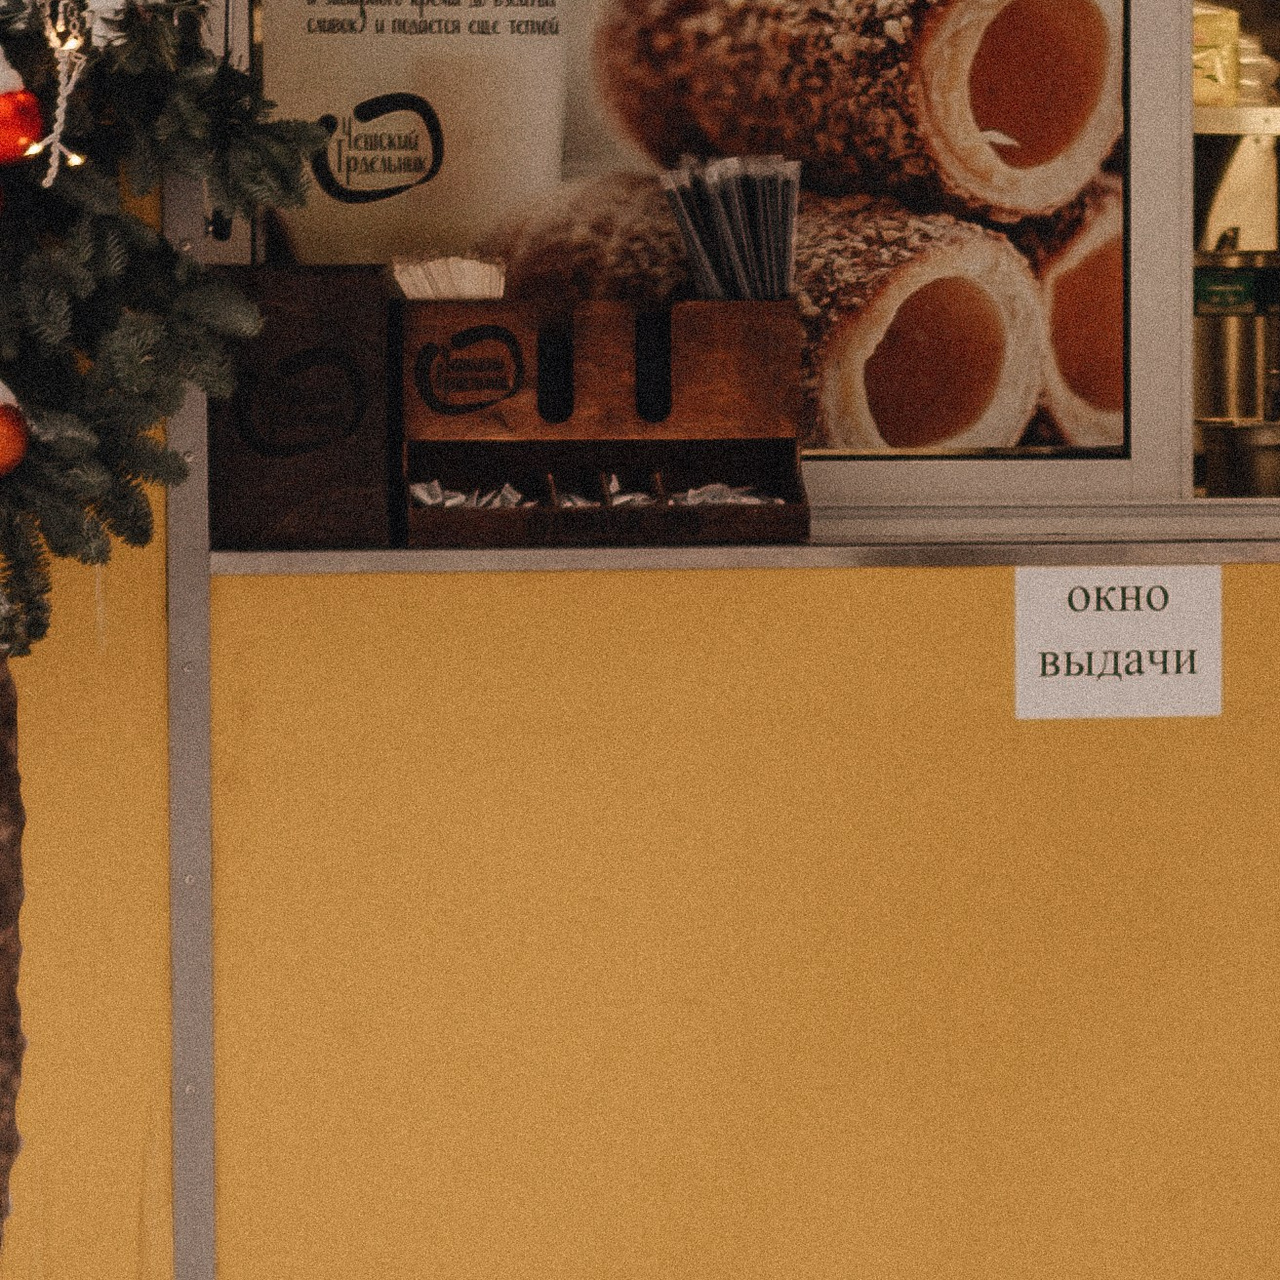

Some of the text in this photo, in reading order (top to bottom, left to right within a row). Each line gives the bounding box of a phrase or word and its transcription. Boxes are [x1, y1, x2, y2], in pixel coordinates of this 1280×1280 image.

[342, 115, 420, 151] Чешский
[1067, 584, 1170, 613] окно
[1038, 648, 1198, 681] выдачи
